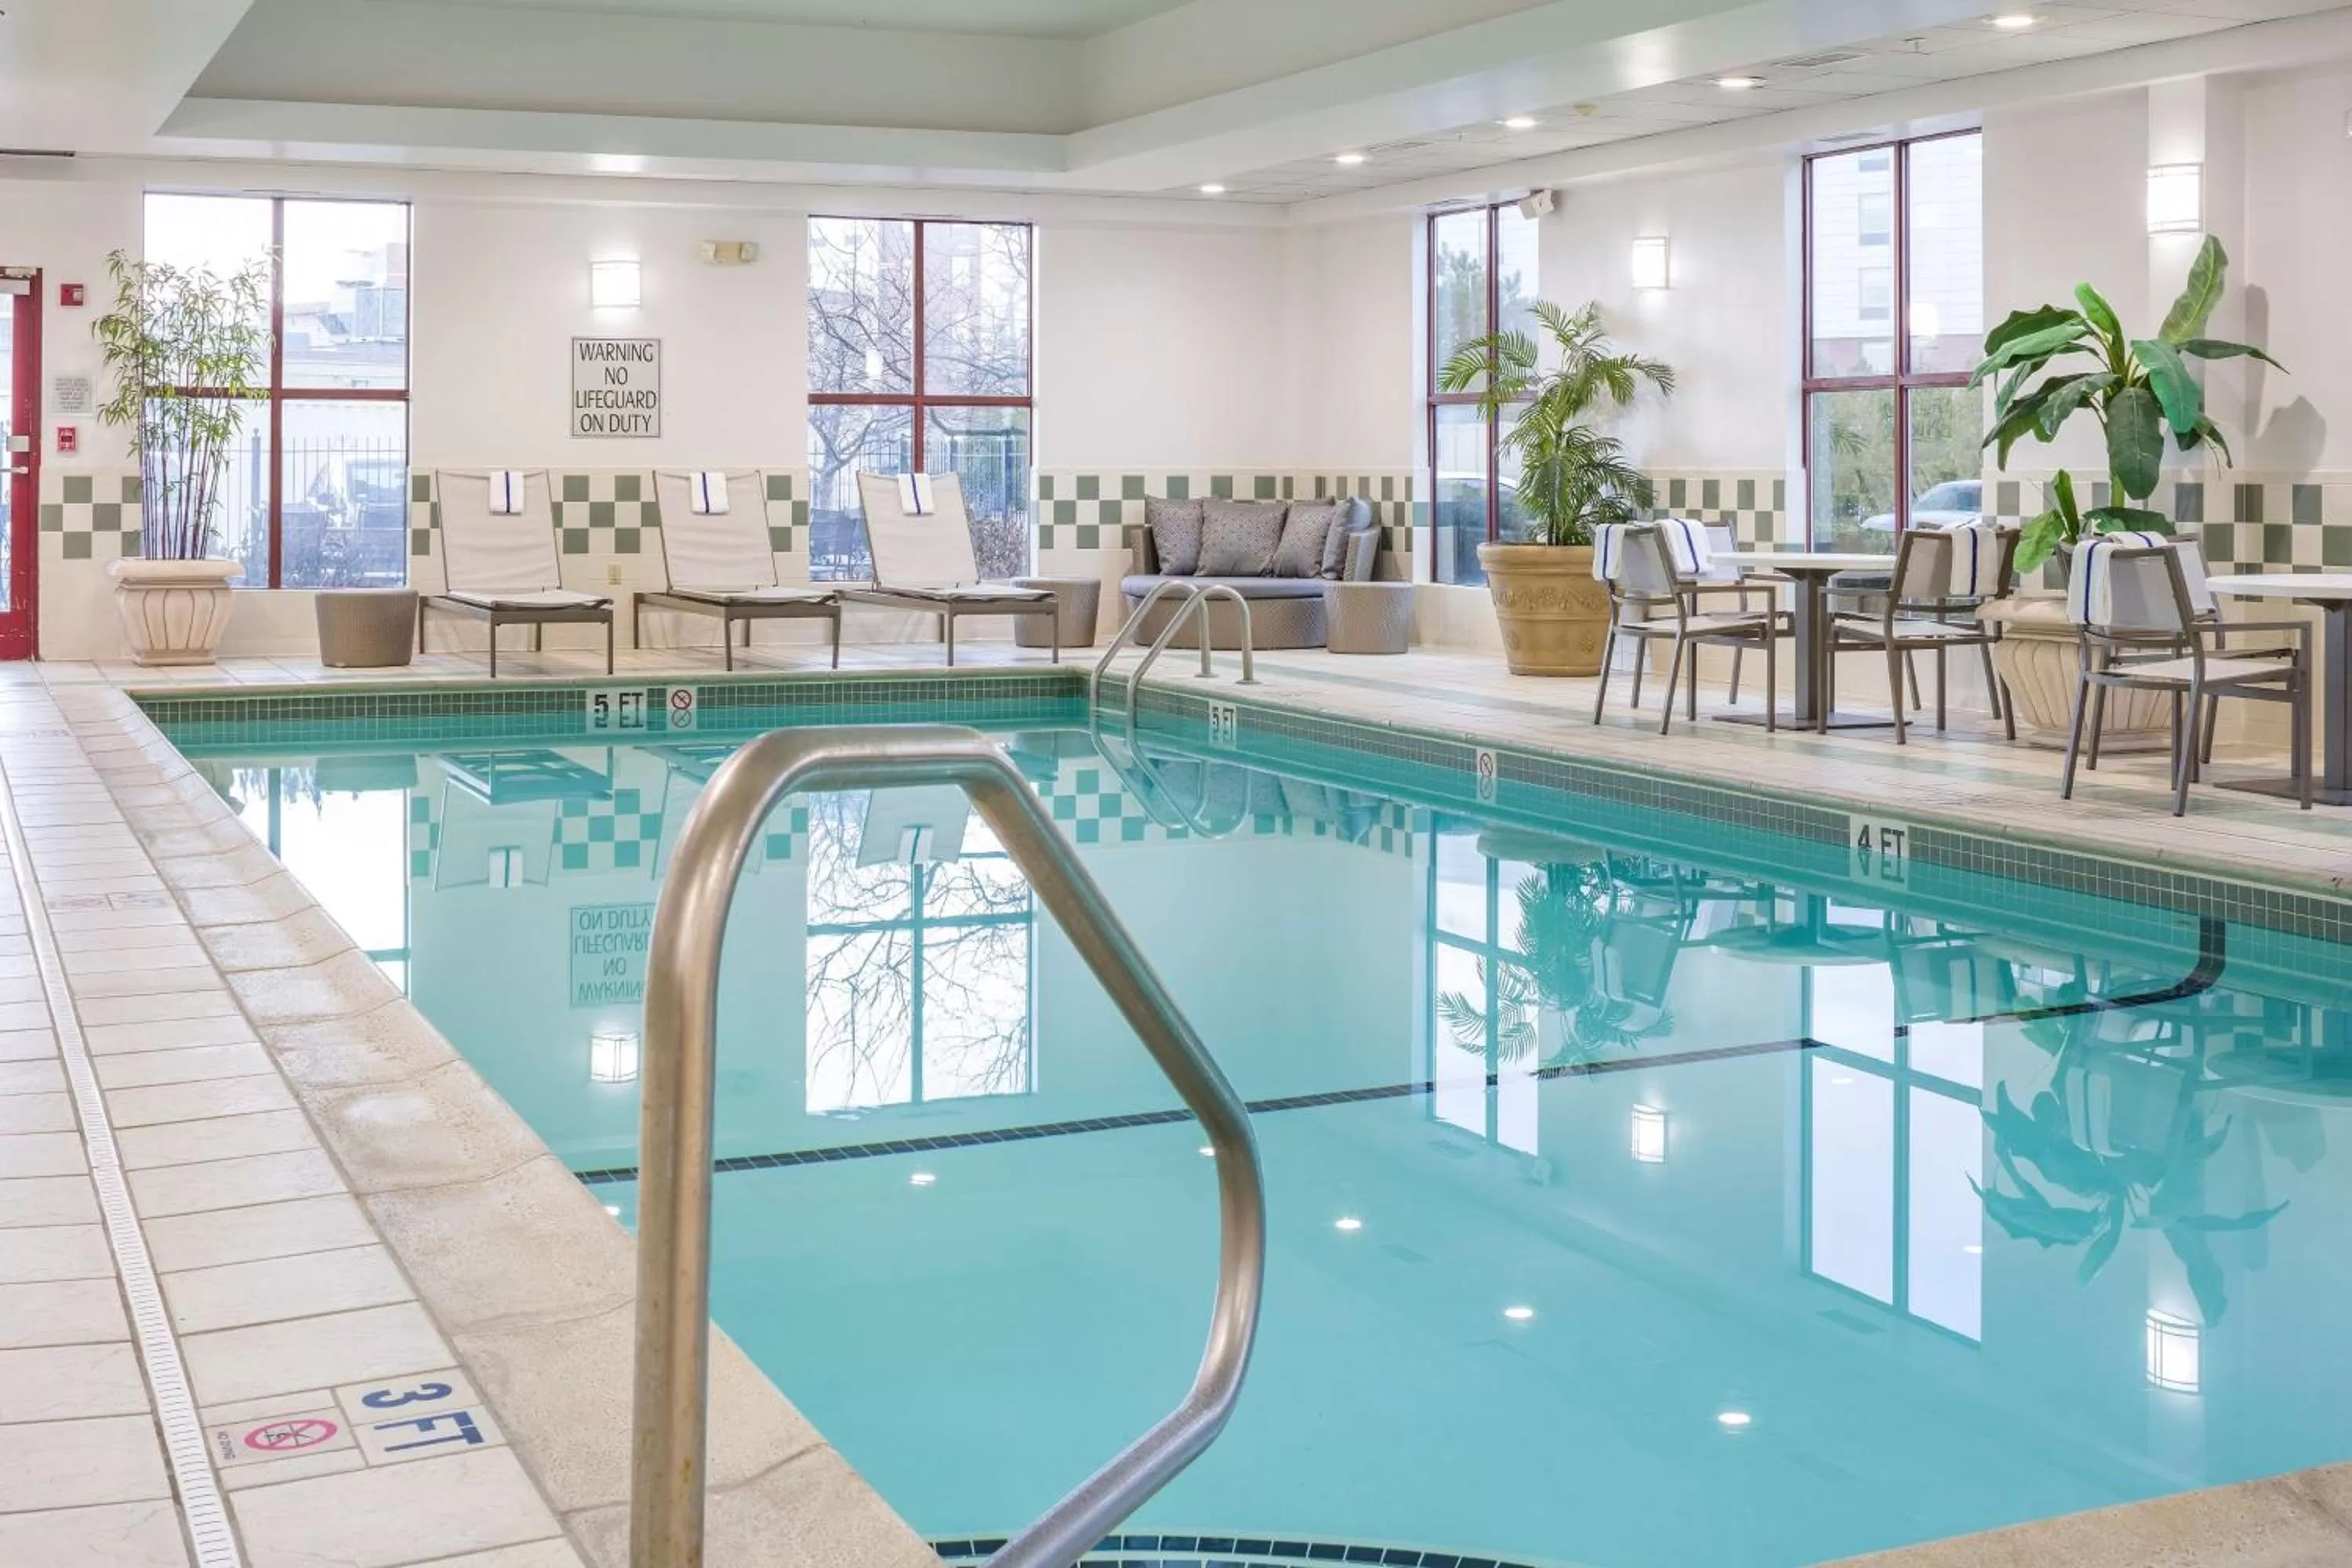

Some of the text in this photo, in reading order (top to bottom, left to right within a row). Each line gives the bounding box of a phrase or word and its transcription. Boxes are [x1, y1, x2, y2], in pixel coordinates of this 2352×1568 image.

[579, 343, 653, 362] WARNING
[604, 366, 628, 385] NO
[576, 390, 656, 408] LIFEGUARD
[580, 413, 652, 433] ON DUTY
[594, 692, 644, 713] 5 FT
[1857, 824, 1905, 857] 4 FT
[361, 1382, 485, 1452] 3 FT
